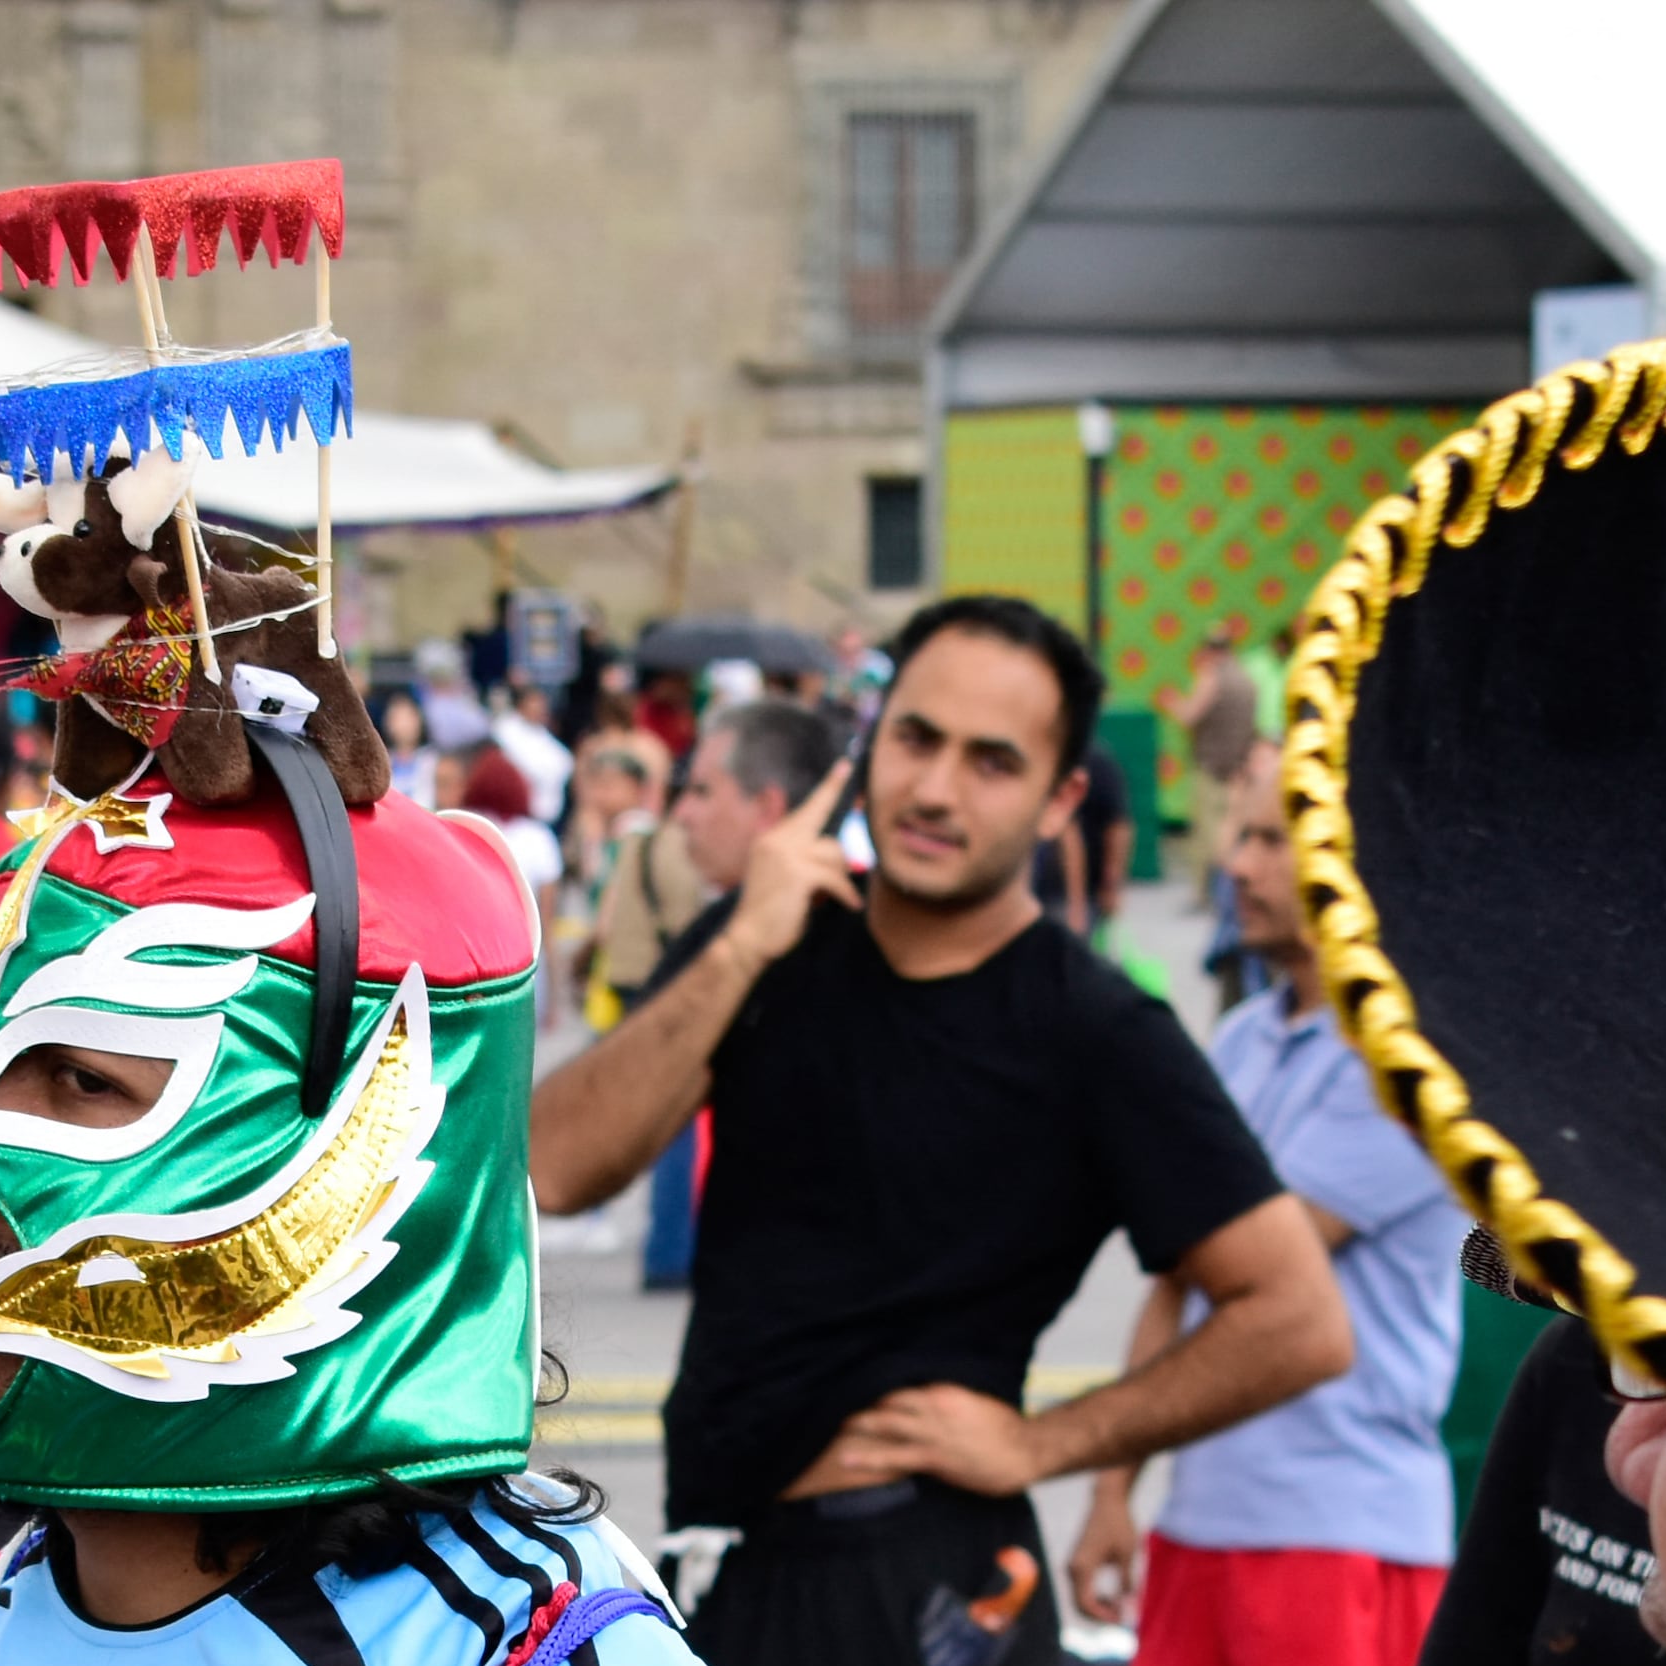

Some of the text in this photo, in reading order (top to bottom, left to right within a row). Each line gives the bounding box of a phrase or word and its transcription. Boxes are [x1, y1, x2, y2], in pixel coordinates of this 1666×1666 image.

[1590, 1535, 1630, 1568] ON
[1555, 1554, 1645, 1606] AND FOR
